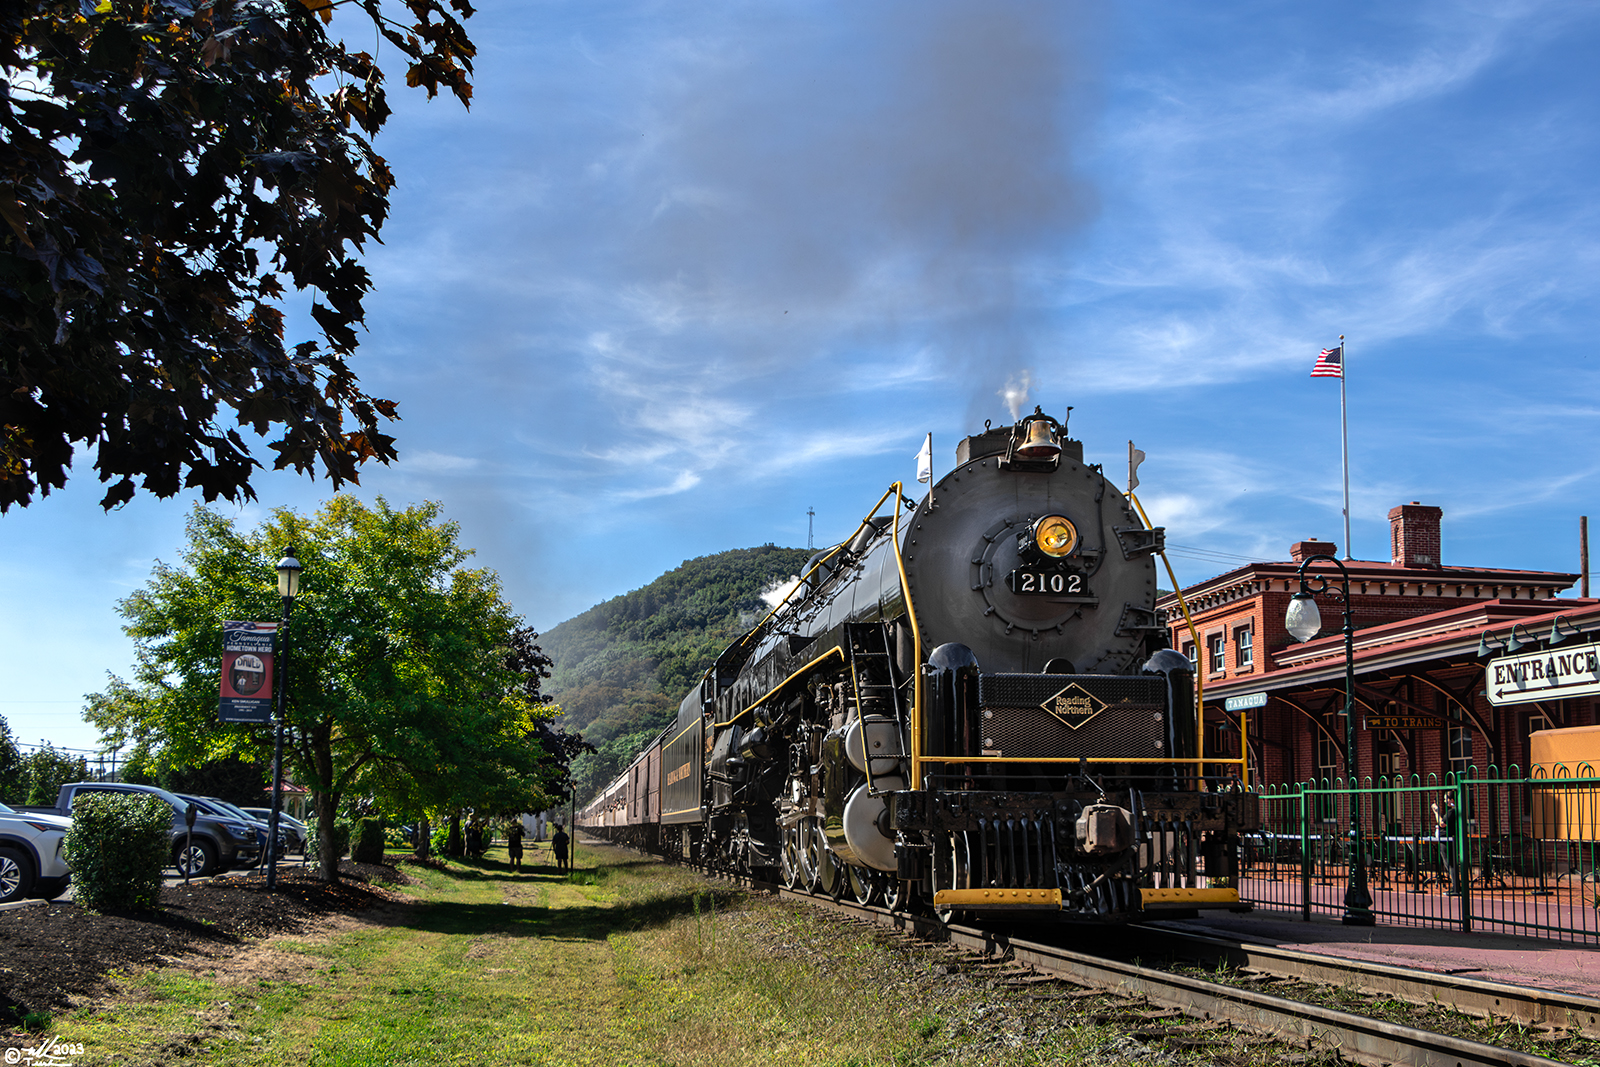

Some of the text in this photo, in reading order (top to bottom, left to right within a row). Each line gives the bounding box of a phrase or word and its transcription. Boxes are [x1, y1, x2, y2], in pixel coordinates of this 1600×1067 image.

[1021, 573, 1082, 593] 2102
[229, 630, 270, 645] Tamaqua
[1494, 651, 1598, 685] ENTRANCE
[1056, 695, 1092, 708] Reading
[1227, 695, 1264, 709] TAMAQUA
[1055, 704, 1093, 715] Northern
[1384, 717, 1442, 727] TO TRAINS
